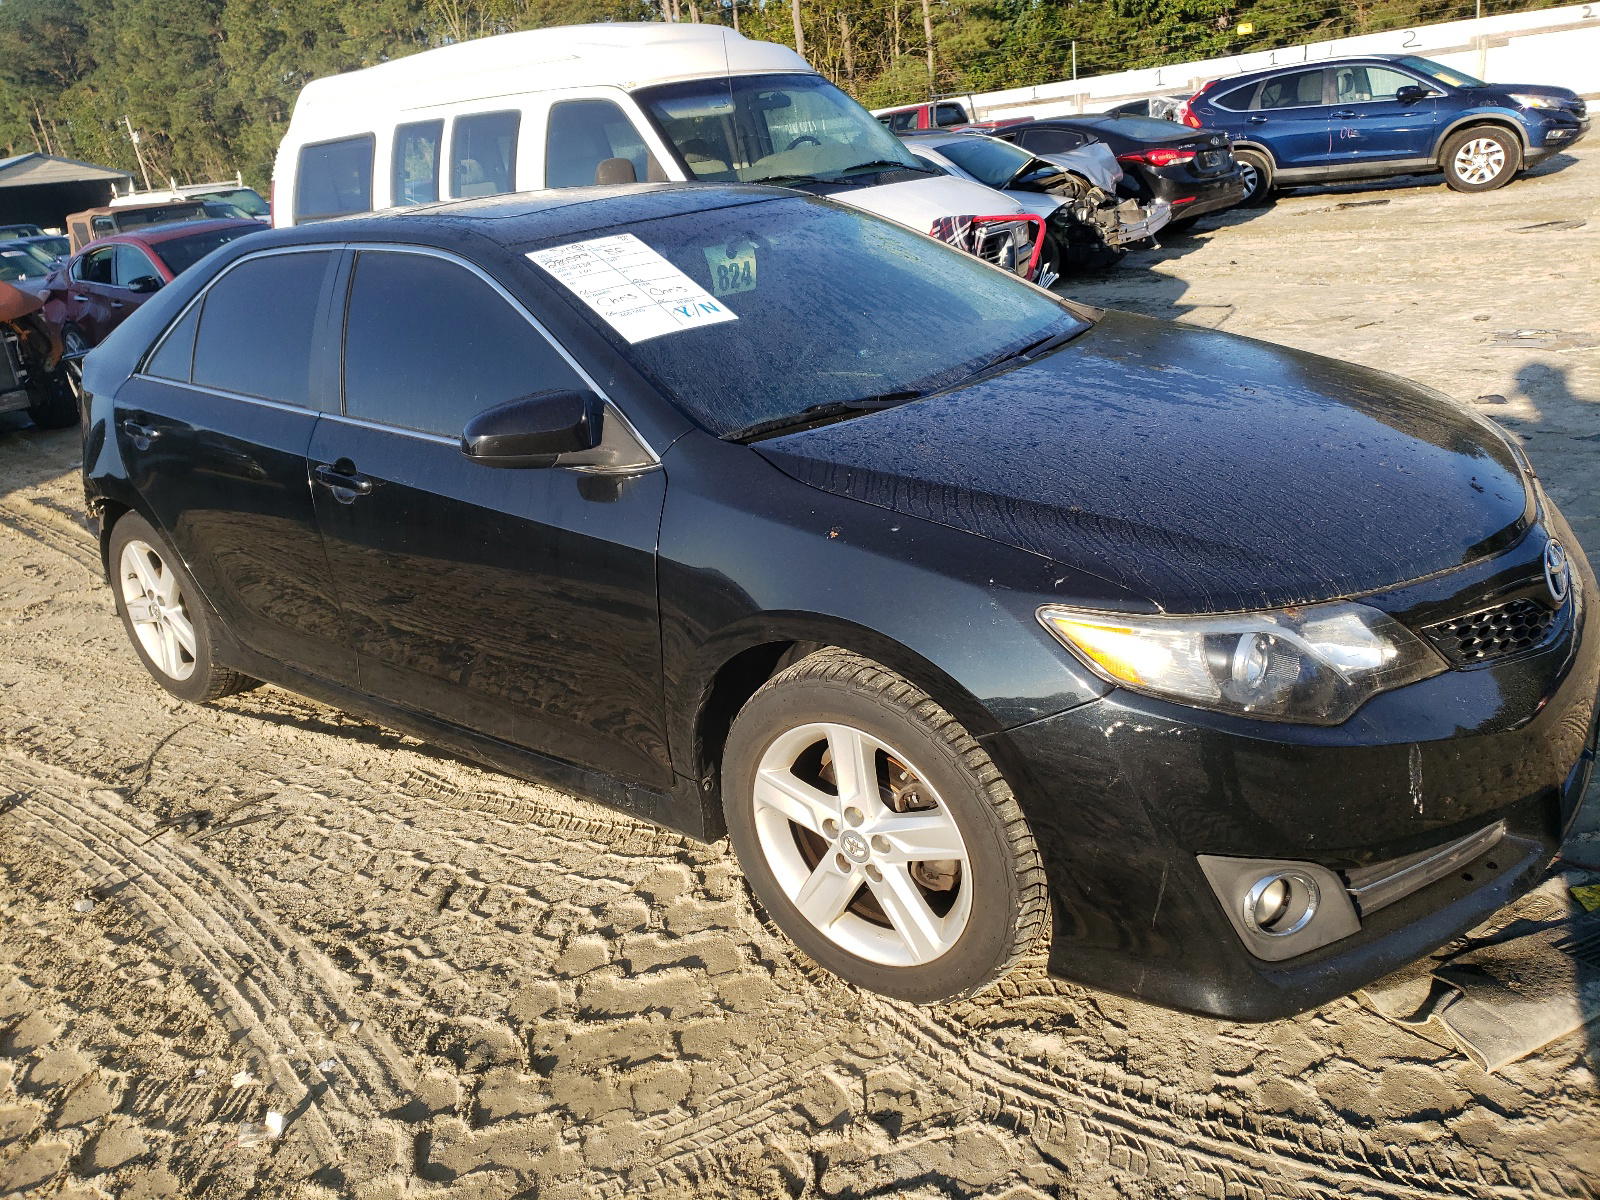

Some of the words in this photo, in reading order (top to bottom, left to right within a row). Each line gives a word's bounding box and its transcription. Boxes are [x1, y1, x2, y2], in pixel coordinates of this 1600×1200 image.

[1582, 5, 1598, 18] 2
[1402, 30, 1422, 49] 2
[716, 260, 753, 293] 824
[596, 293, 638, 307] Chris
[672, 301, 722, 318] Y/N
